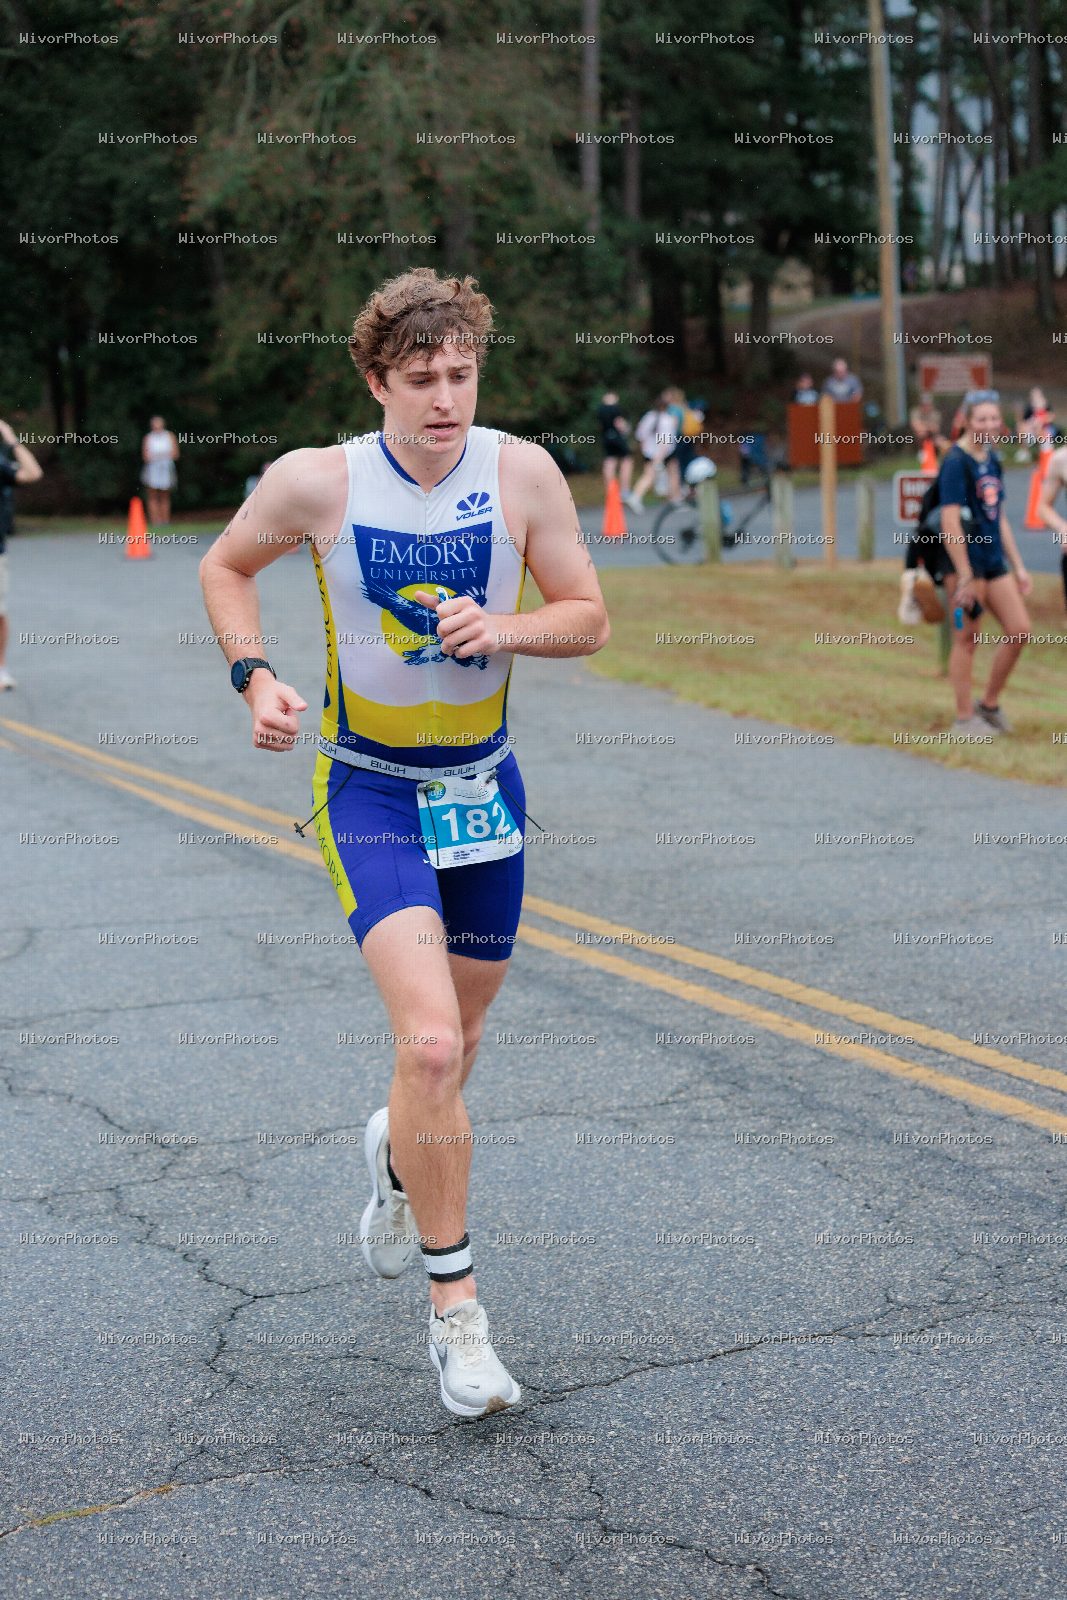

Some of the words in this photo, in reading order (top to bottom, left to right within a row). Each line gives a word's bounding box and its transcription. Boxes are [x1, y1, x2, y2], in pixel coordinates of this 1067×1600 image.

[456, 506, 493, 521] VOLER
[369, 537, 475, 567] EMORY
[370, 566, 478, 581] UNIVERSITY
[441, 801, 511, 842] 182
